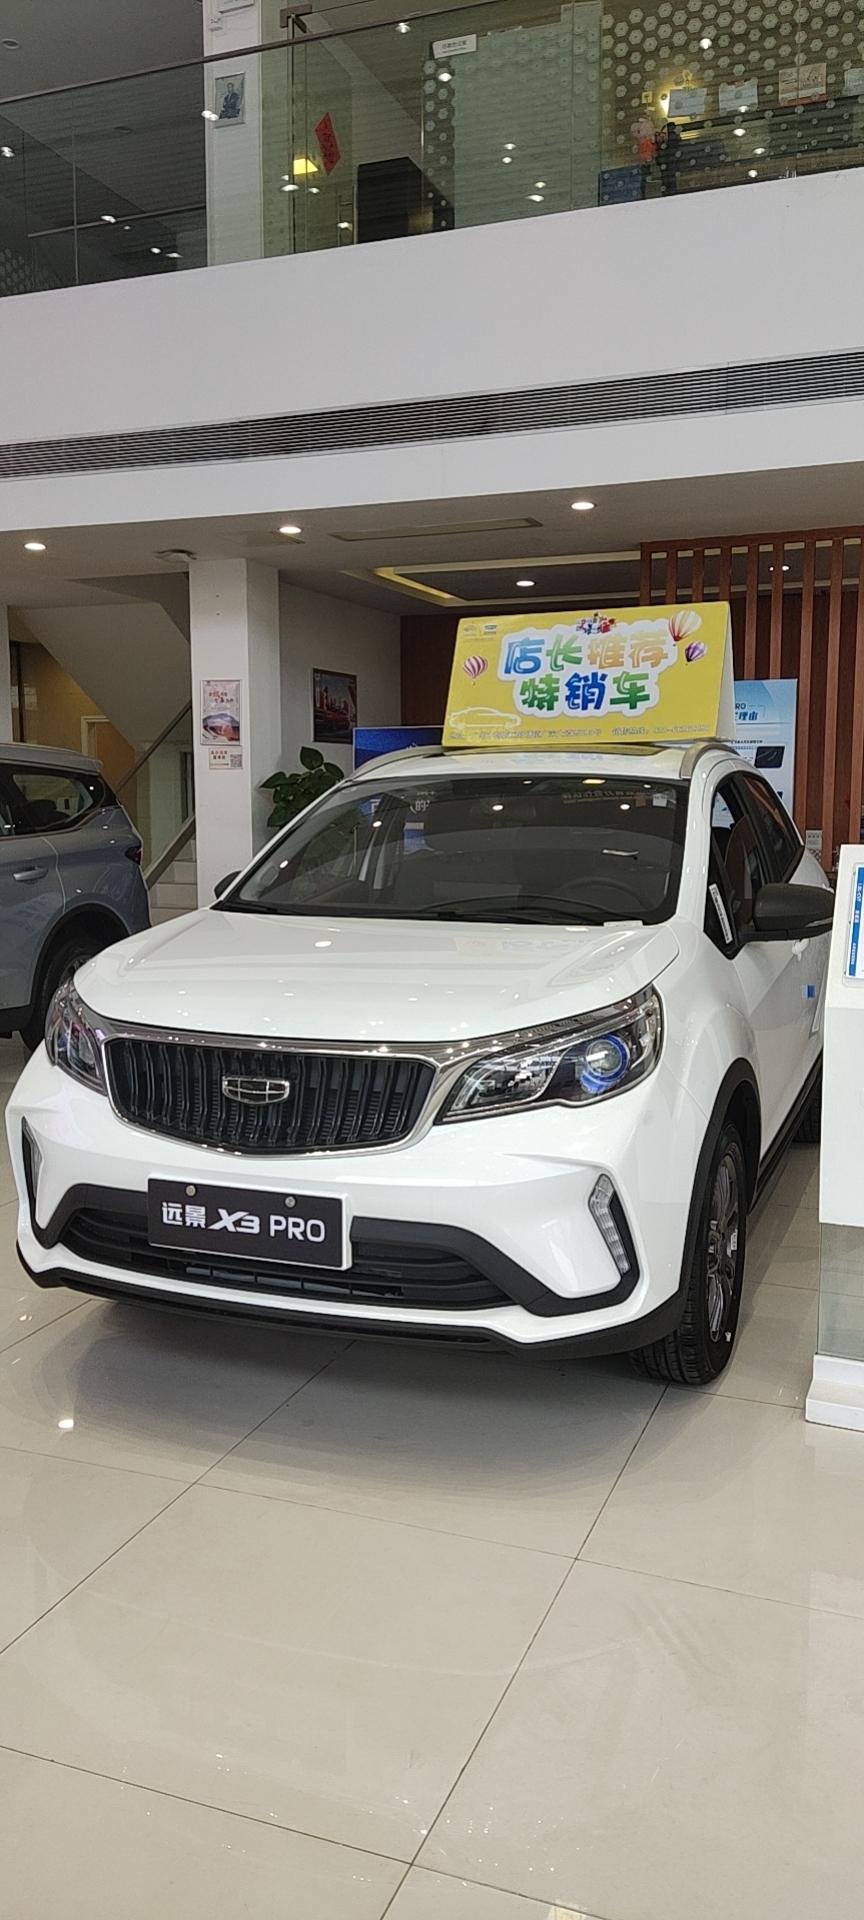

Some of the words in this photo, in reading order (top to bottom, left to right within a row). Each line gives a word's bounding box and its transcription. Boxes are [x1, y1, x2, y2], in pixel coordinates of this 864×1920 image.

[504, 632, 668, 674] 店长推荐
[520, 671, 650, 711] 特销车
[734, 702, 747, 711] RO
[162, 1202, 206, 1228] 远景
[208, 1208, 260, 1234] X3
[269, 1214, 326, 1242] PRO
